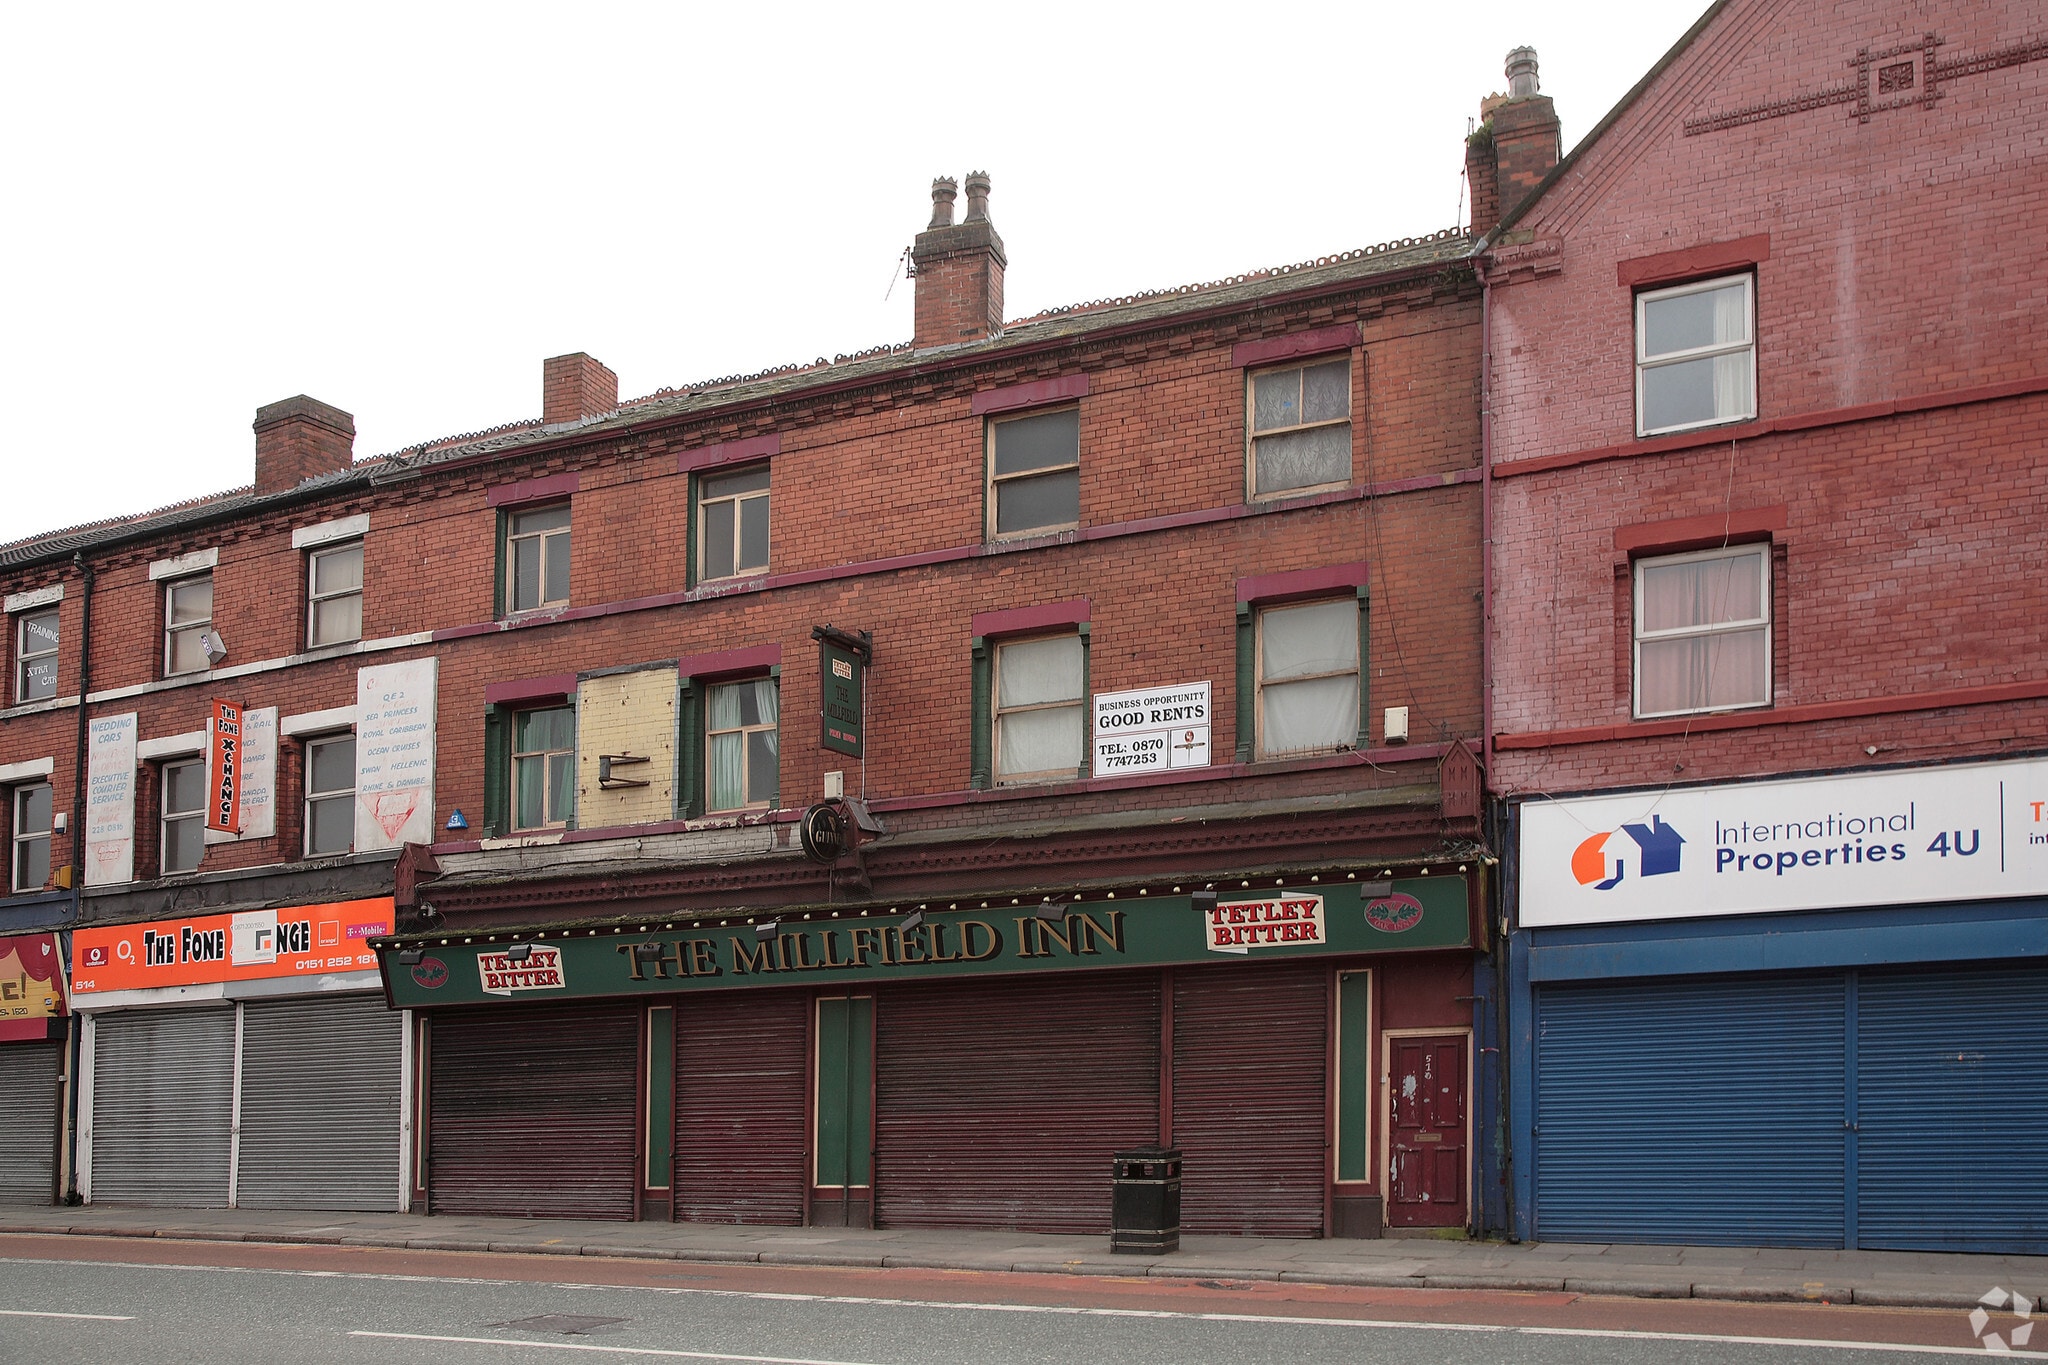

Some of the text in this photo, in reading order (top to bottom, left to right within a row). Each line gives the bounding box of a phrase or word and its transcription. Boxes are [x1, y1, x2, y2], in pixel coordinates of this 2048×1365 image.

[27, 621, 59, 643] TRAINING
[836, 685, 848, 703] THE
[1099, 691, 1205, 711] BUSINESS OPPORTUNITY
[221, 704, 236, 720] THE
[384, 707, 418, 718] PRINCESS
[827, 702, 858, 725] MILLFIELD
[1099, 704, 1205, 729] GOOD RENTS
[91, 719, 132, 733] WEDDING
[218, 719, 239, 736] FONE
[254, 720, 272, 729] RAIL
[362, 723, 427, 739] ROYAL CARIBBEAN
[98, 732, 122, 744] CARS
[1098, 743, 1128, 755] TEL:
[1132, 738, 1164, 752] 0870
[367, 741, 420, 756] OCEAN CRUISES
[360, 758, 427, 775] SWAN HELLENIC
[1105, 752, 1158, 768] 7747253
[92, 772, 129, 785] EXECUTIVE
[220, 738, 237, 826] XCHANGE
[362, 777, 426, 792] RHINE & DANUBE
[92, 782, 128, 794] COURIER
[241, 788, 266, 797] ANADA
[92, 792, 124, 805] SERVICE
[252, 796, 269, 804] EAST
[1715, 801, 1916, 846] International
[1716, 829, 1980, 876] Properties 4U
[1208, 899, 1319, 925] TETLEY
[1213, 921, 1319, 946] BITTER
[144, 929, 176, 967] THE
[181, 926, 225, 964] FONE
[616, 911, 1125, 980] THE MILLFIELD INN
[295, 953, 378, 970] 0151 252 181
[480, 951, 558, 971] TETLEY
[75, 980, 96, 990] 514
[485, 969, 562, 988] BITTER
